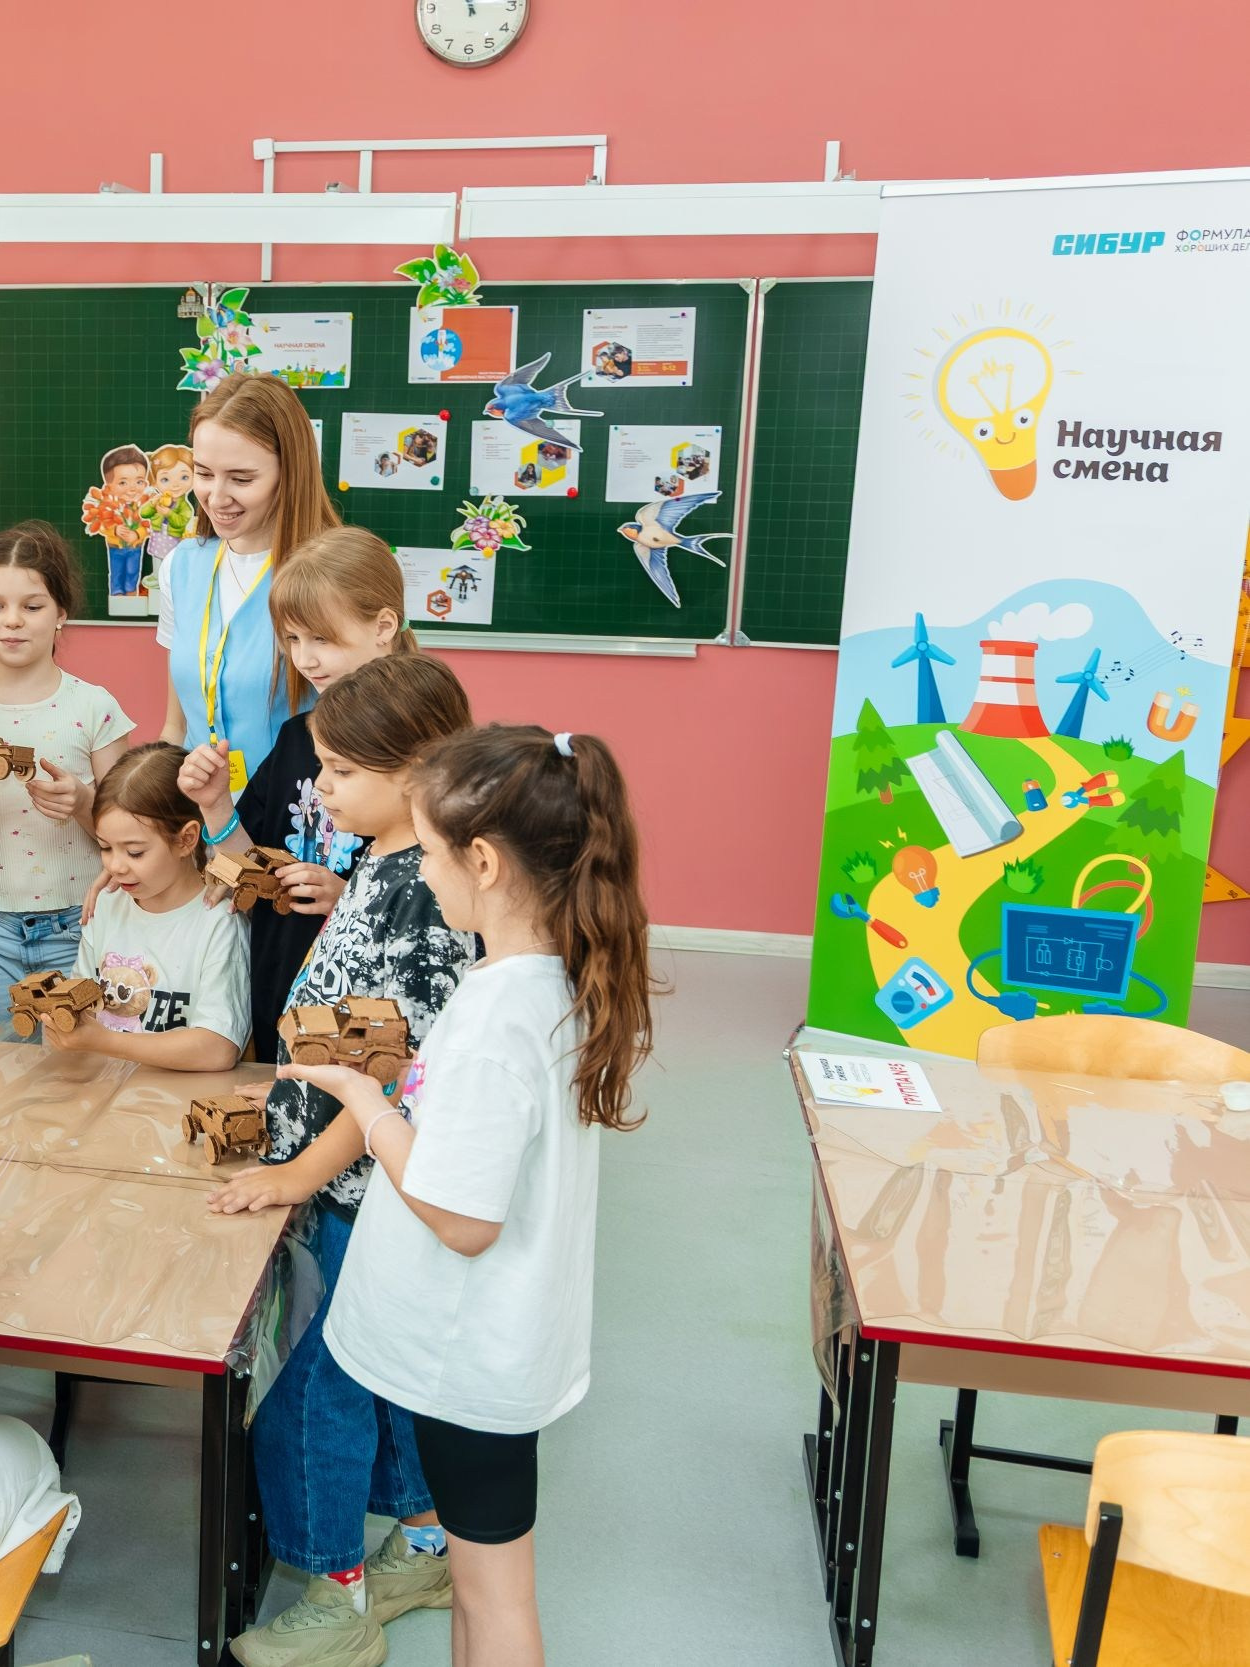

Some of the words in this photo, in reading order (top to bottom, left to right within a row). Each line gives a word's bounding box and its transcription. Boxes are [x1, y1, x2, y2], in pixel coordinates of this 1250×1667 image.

[426, 3, 436, 14] 9
[506, 0, 517, 12] 3
[430, 24, 442, 35] 8
[499, 22, 510, 33] 4
[444, 39, 454, 50] 7
[484, 38, 495, 49] 5
[463, 44, 474, 55] 6
[1052, 231, 1166, 256] СИБУР
[1174, 243, 1230, 253] ХОРОШИХ
[1056, 419, 1223, 457] Научная
[1052, 458, 1169, 483] смена
